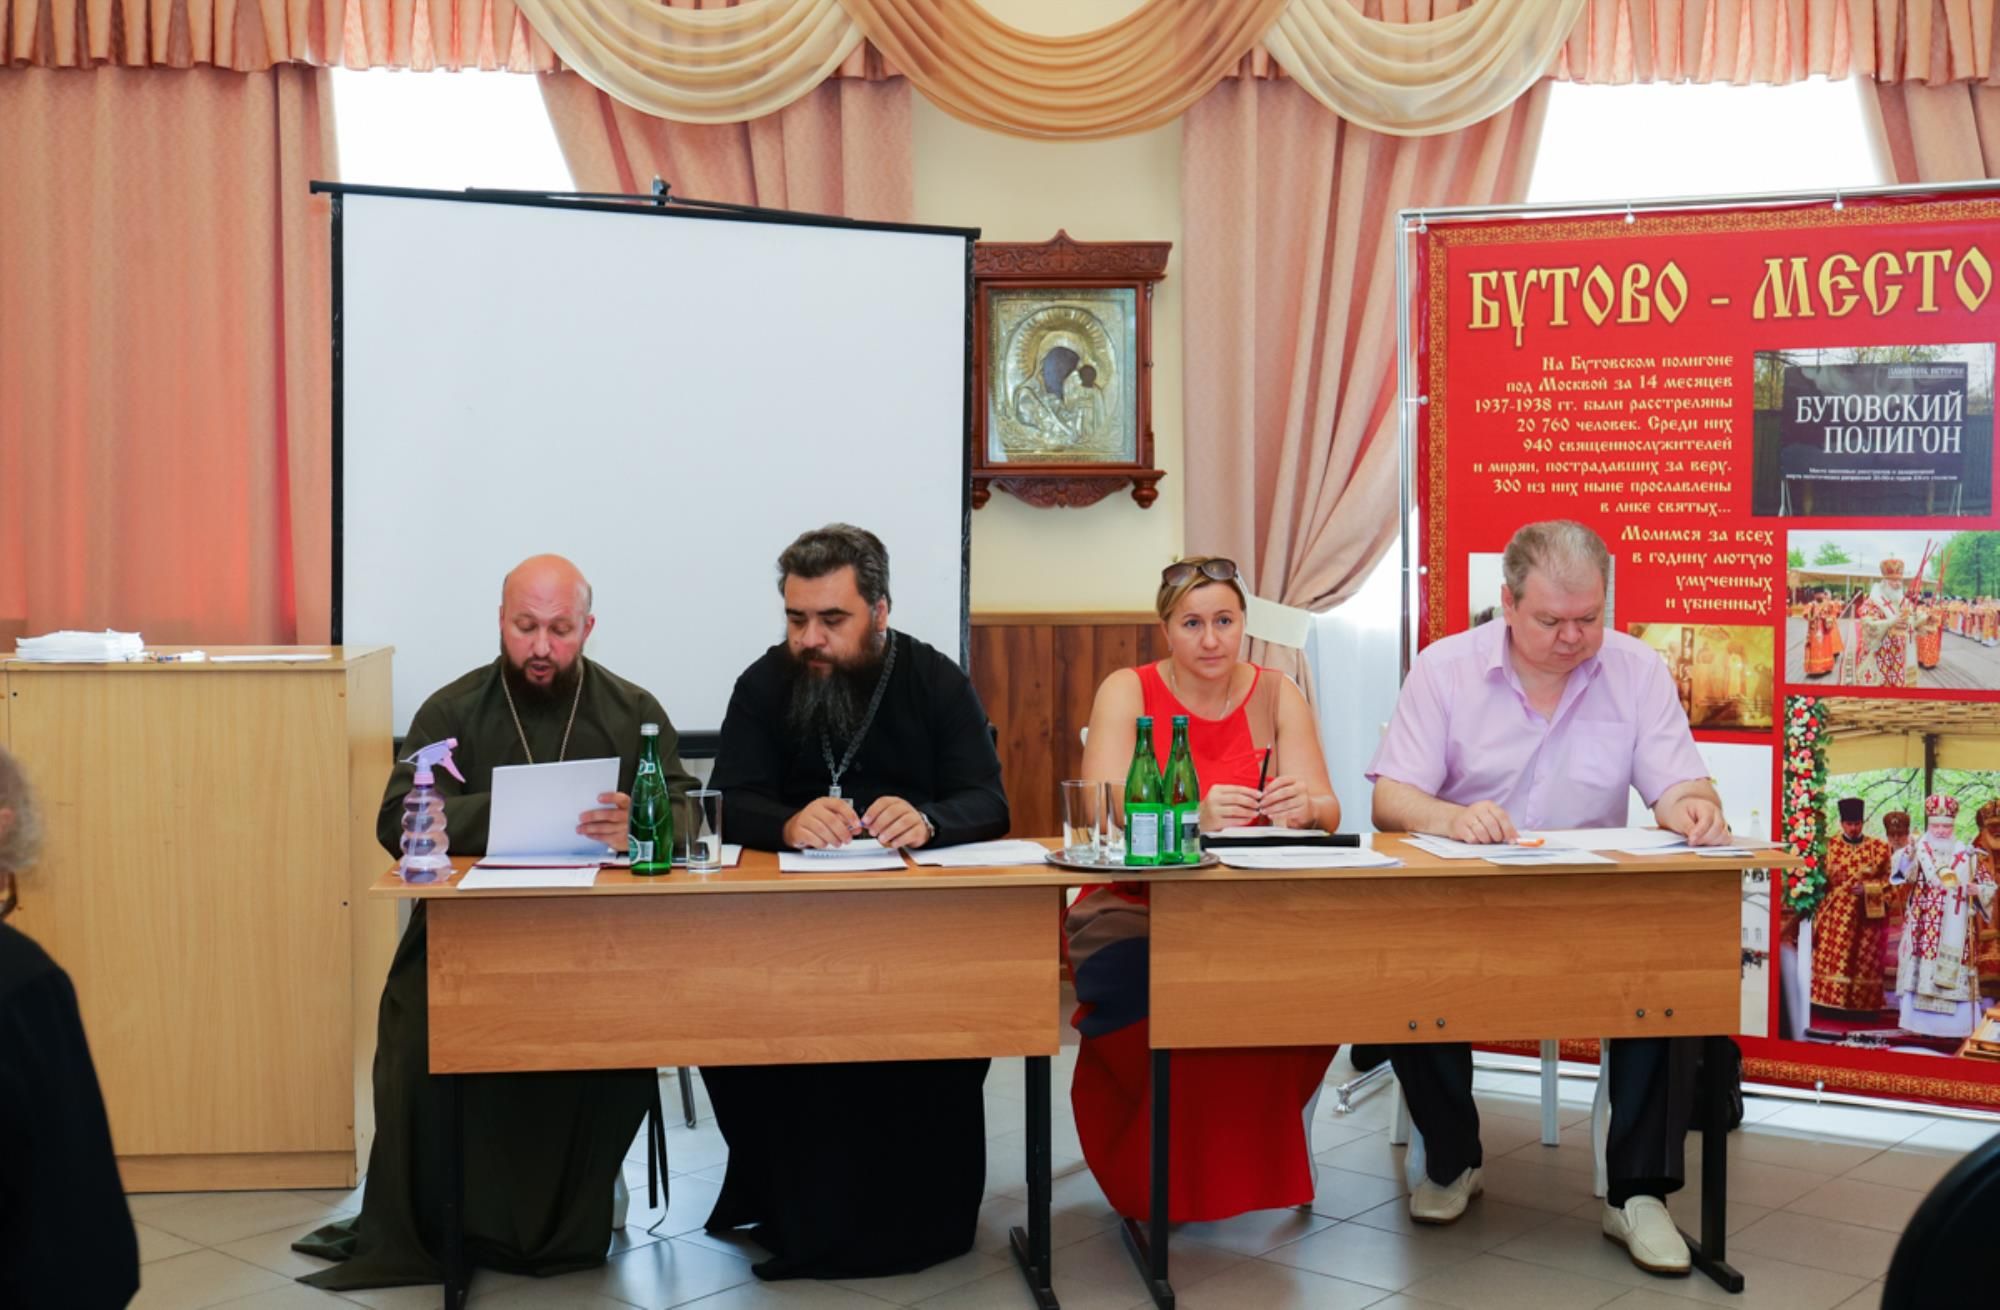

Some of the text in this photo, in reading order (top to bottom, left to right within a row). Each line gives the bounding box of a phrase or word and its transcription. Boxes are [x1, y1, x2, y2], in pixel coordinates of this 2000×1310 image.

[1467, 260, 1688, 347] БУТОВО
[1752, 246, 1993, 319] МЕСТО
[1542, 355, 1733, 374] На Бутовском полигоне
[1506, 374, 1733, 394] под Москвой за 14 месяцев
[1474, 397, 1733, 413] 1937-1938 гг. были расстреляны
[1795, 390, 1964, 423] БУТОВСКИЙ
[1516, 415, 1733, 433] 20 760 человек. Среди них
[1523, 437, 1732, 456] 940 священнослужителей
[1823, 426, 1963, 454] ПОЛИГОН
[1473, 460, 1732, 476] и мирян, пострадавших за веру.
[1493, 479, 1732, 496] 300 из них ныне прославлены
[1600, 501, 1732, 517] в лике святых...
[1621, 525, 1774, 546] Молимся за всех
[1632, 551, 1773, 569] в годину лютую
[1675, 575, 1773, 592] умученных
[1665, 594, 1773, 615] и убиенных!
